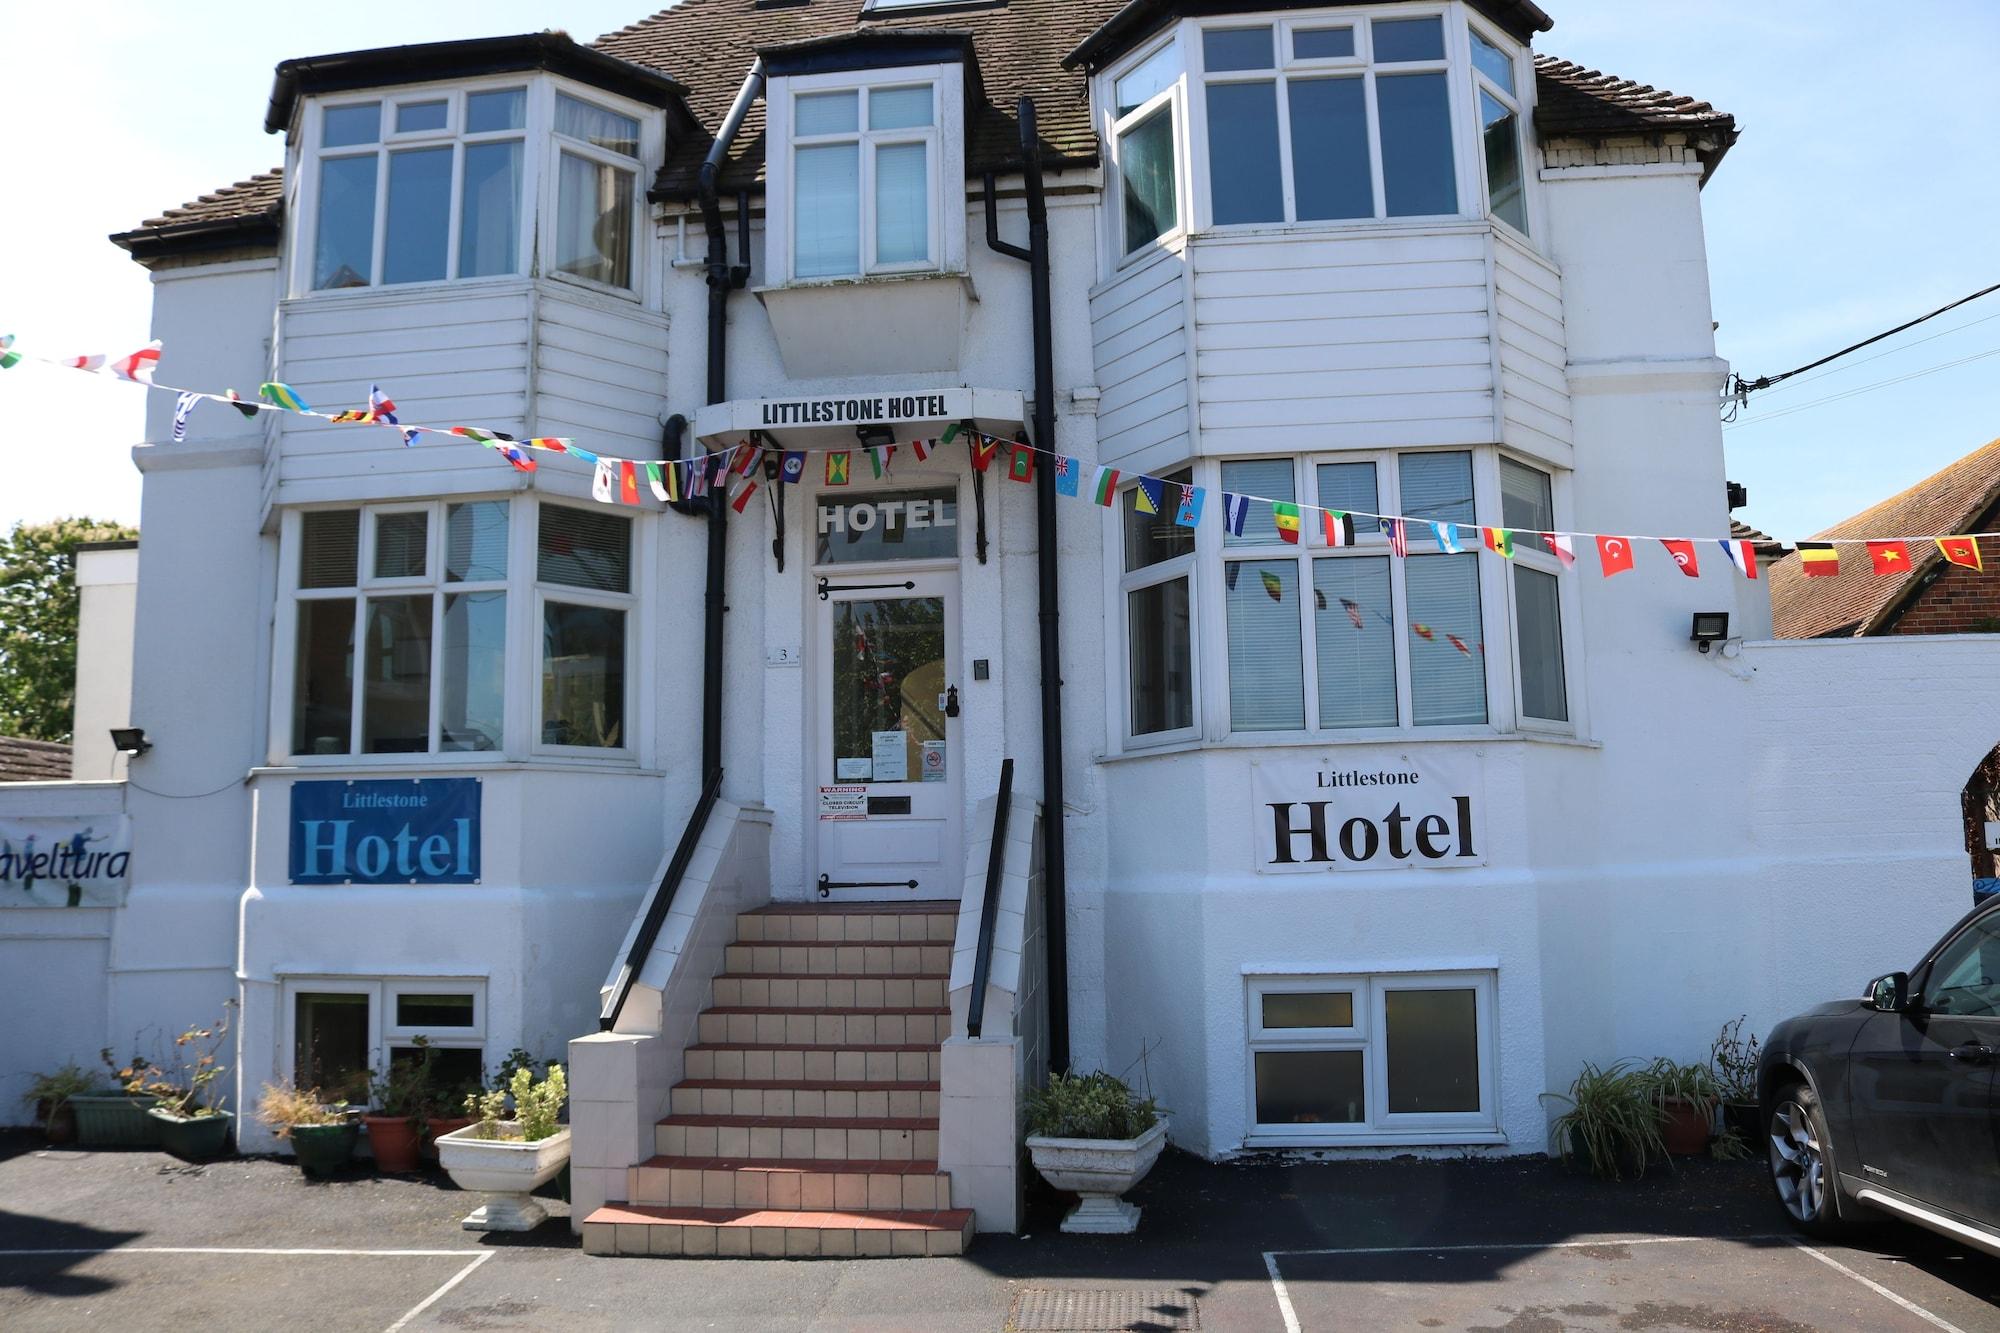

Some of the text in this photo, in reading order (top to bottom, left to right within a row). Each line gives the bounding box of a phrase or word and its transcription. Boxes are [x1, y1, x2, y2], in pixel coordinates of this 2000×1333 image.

[763, 395, 948, 424] LITTLESTONE HOTEL
[818, 499, 956, 534] HOTEL
[779, 649, 787, 661] 3
[1317, 770, 1419, 788] Littlestone
[343, 792, 428, 809] Littlestone
[1265, 796, 1478, 864] Hotel
[299, 818, 473, 877] Hotel
